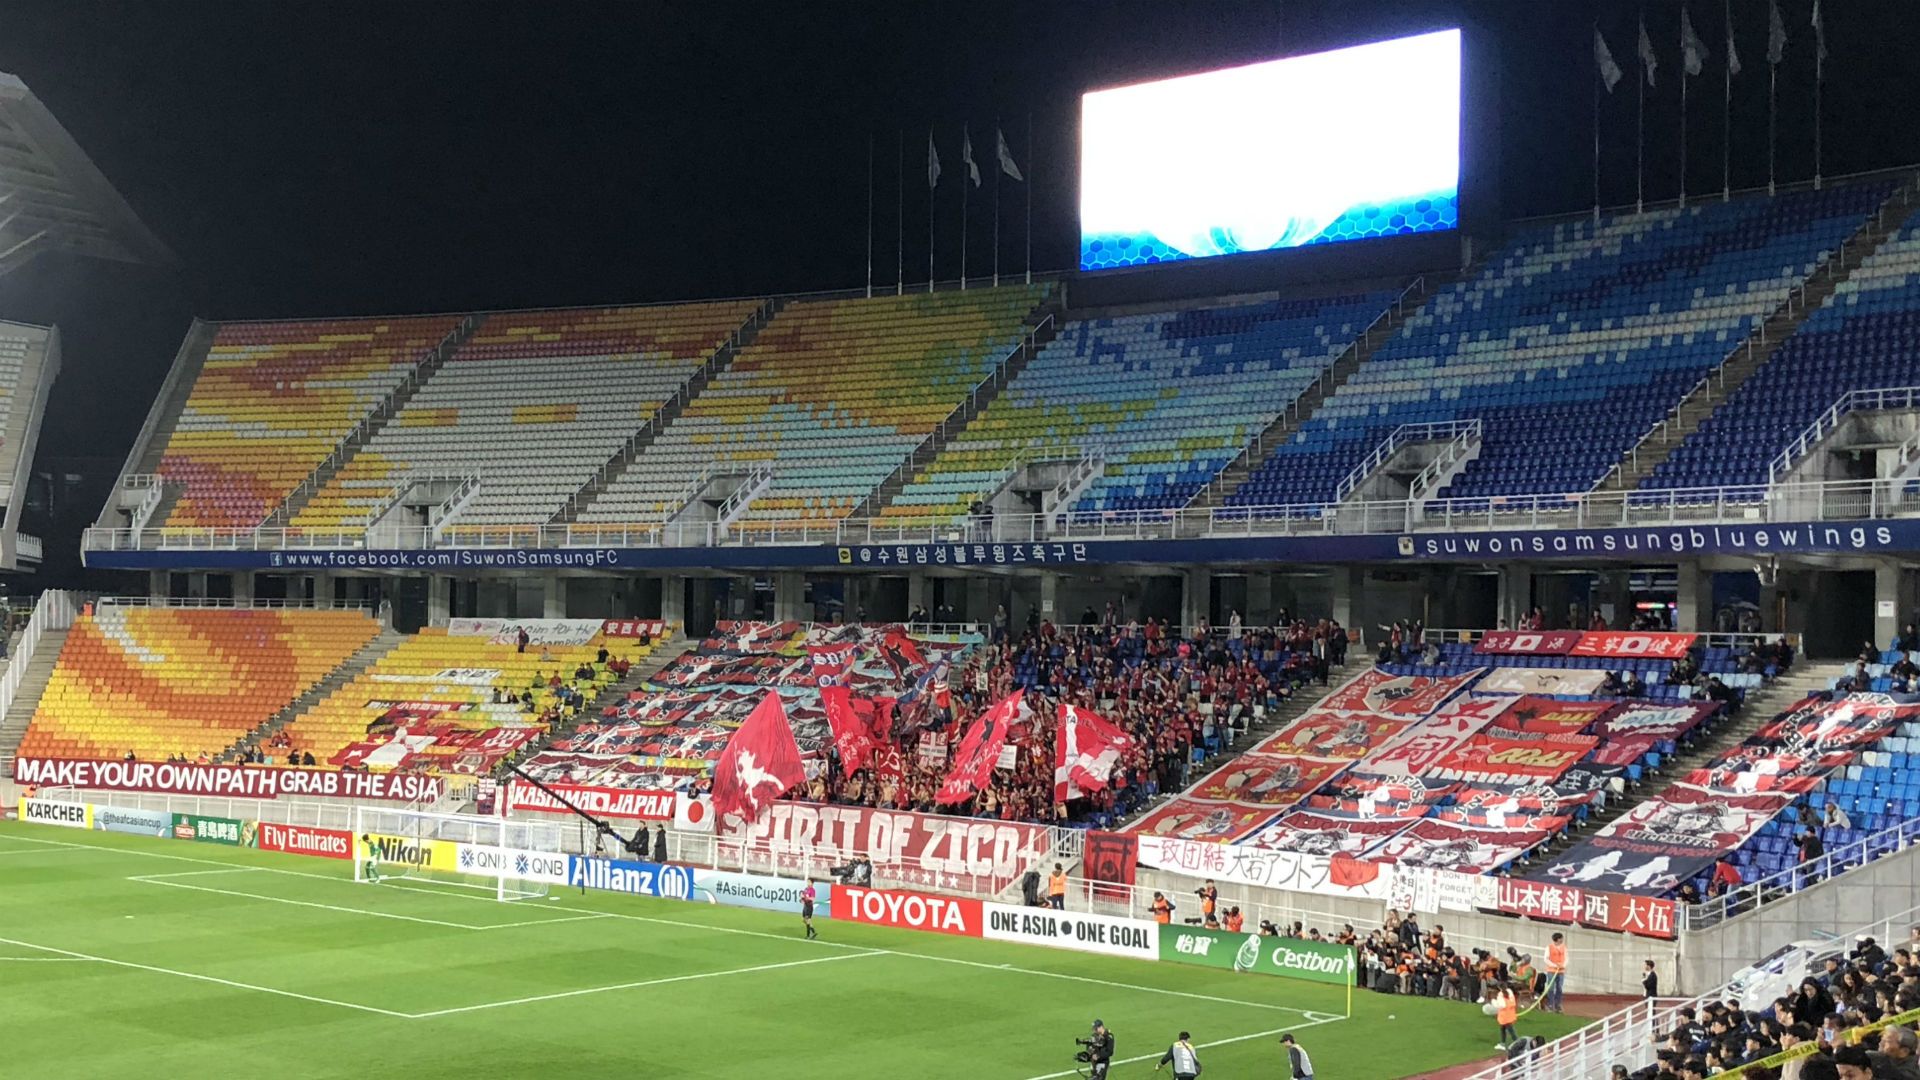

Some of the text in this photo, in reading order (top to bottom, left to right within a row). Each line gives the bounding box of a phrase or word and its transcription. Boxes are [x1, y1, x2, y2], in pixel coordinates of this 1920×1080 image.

[860, 544, 1087, 563] @수원삼성블루윙즈축구단
[1426, 524, 1892, 554] suwonsamsungbluewings
[287, 550, 618, 567] www.facebook.com/SuwonSamsungFC
[17, 757, 439, 799] MAKE YOUR OWN PATH GRAB THE ASIA
[27, 802, 84, 822] KÄRCHER
[608, 792, 673, 816] JAPAN
[103, 811, 161, 829] @theafcasiancup
[722, 804, 862, 856] SPIRIT
[868, 811, 915, 862] OF
[264, 825, 347, 854] Fly Emirates
[378, 837, 432, 866] Nikon
[532, 856, 564, 876] QNB
[1141, 840, 1226, 872] 一致団結
[572, 856, 653, 894] Allianz
[846, 889, 966, 931] TOYOTA
[1584, 893, 1671, 933] 西 大伍
[990, 910, 1151, 949] ONE ASIA ONE GOAL
